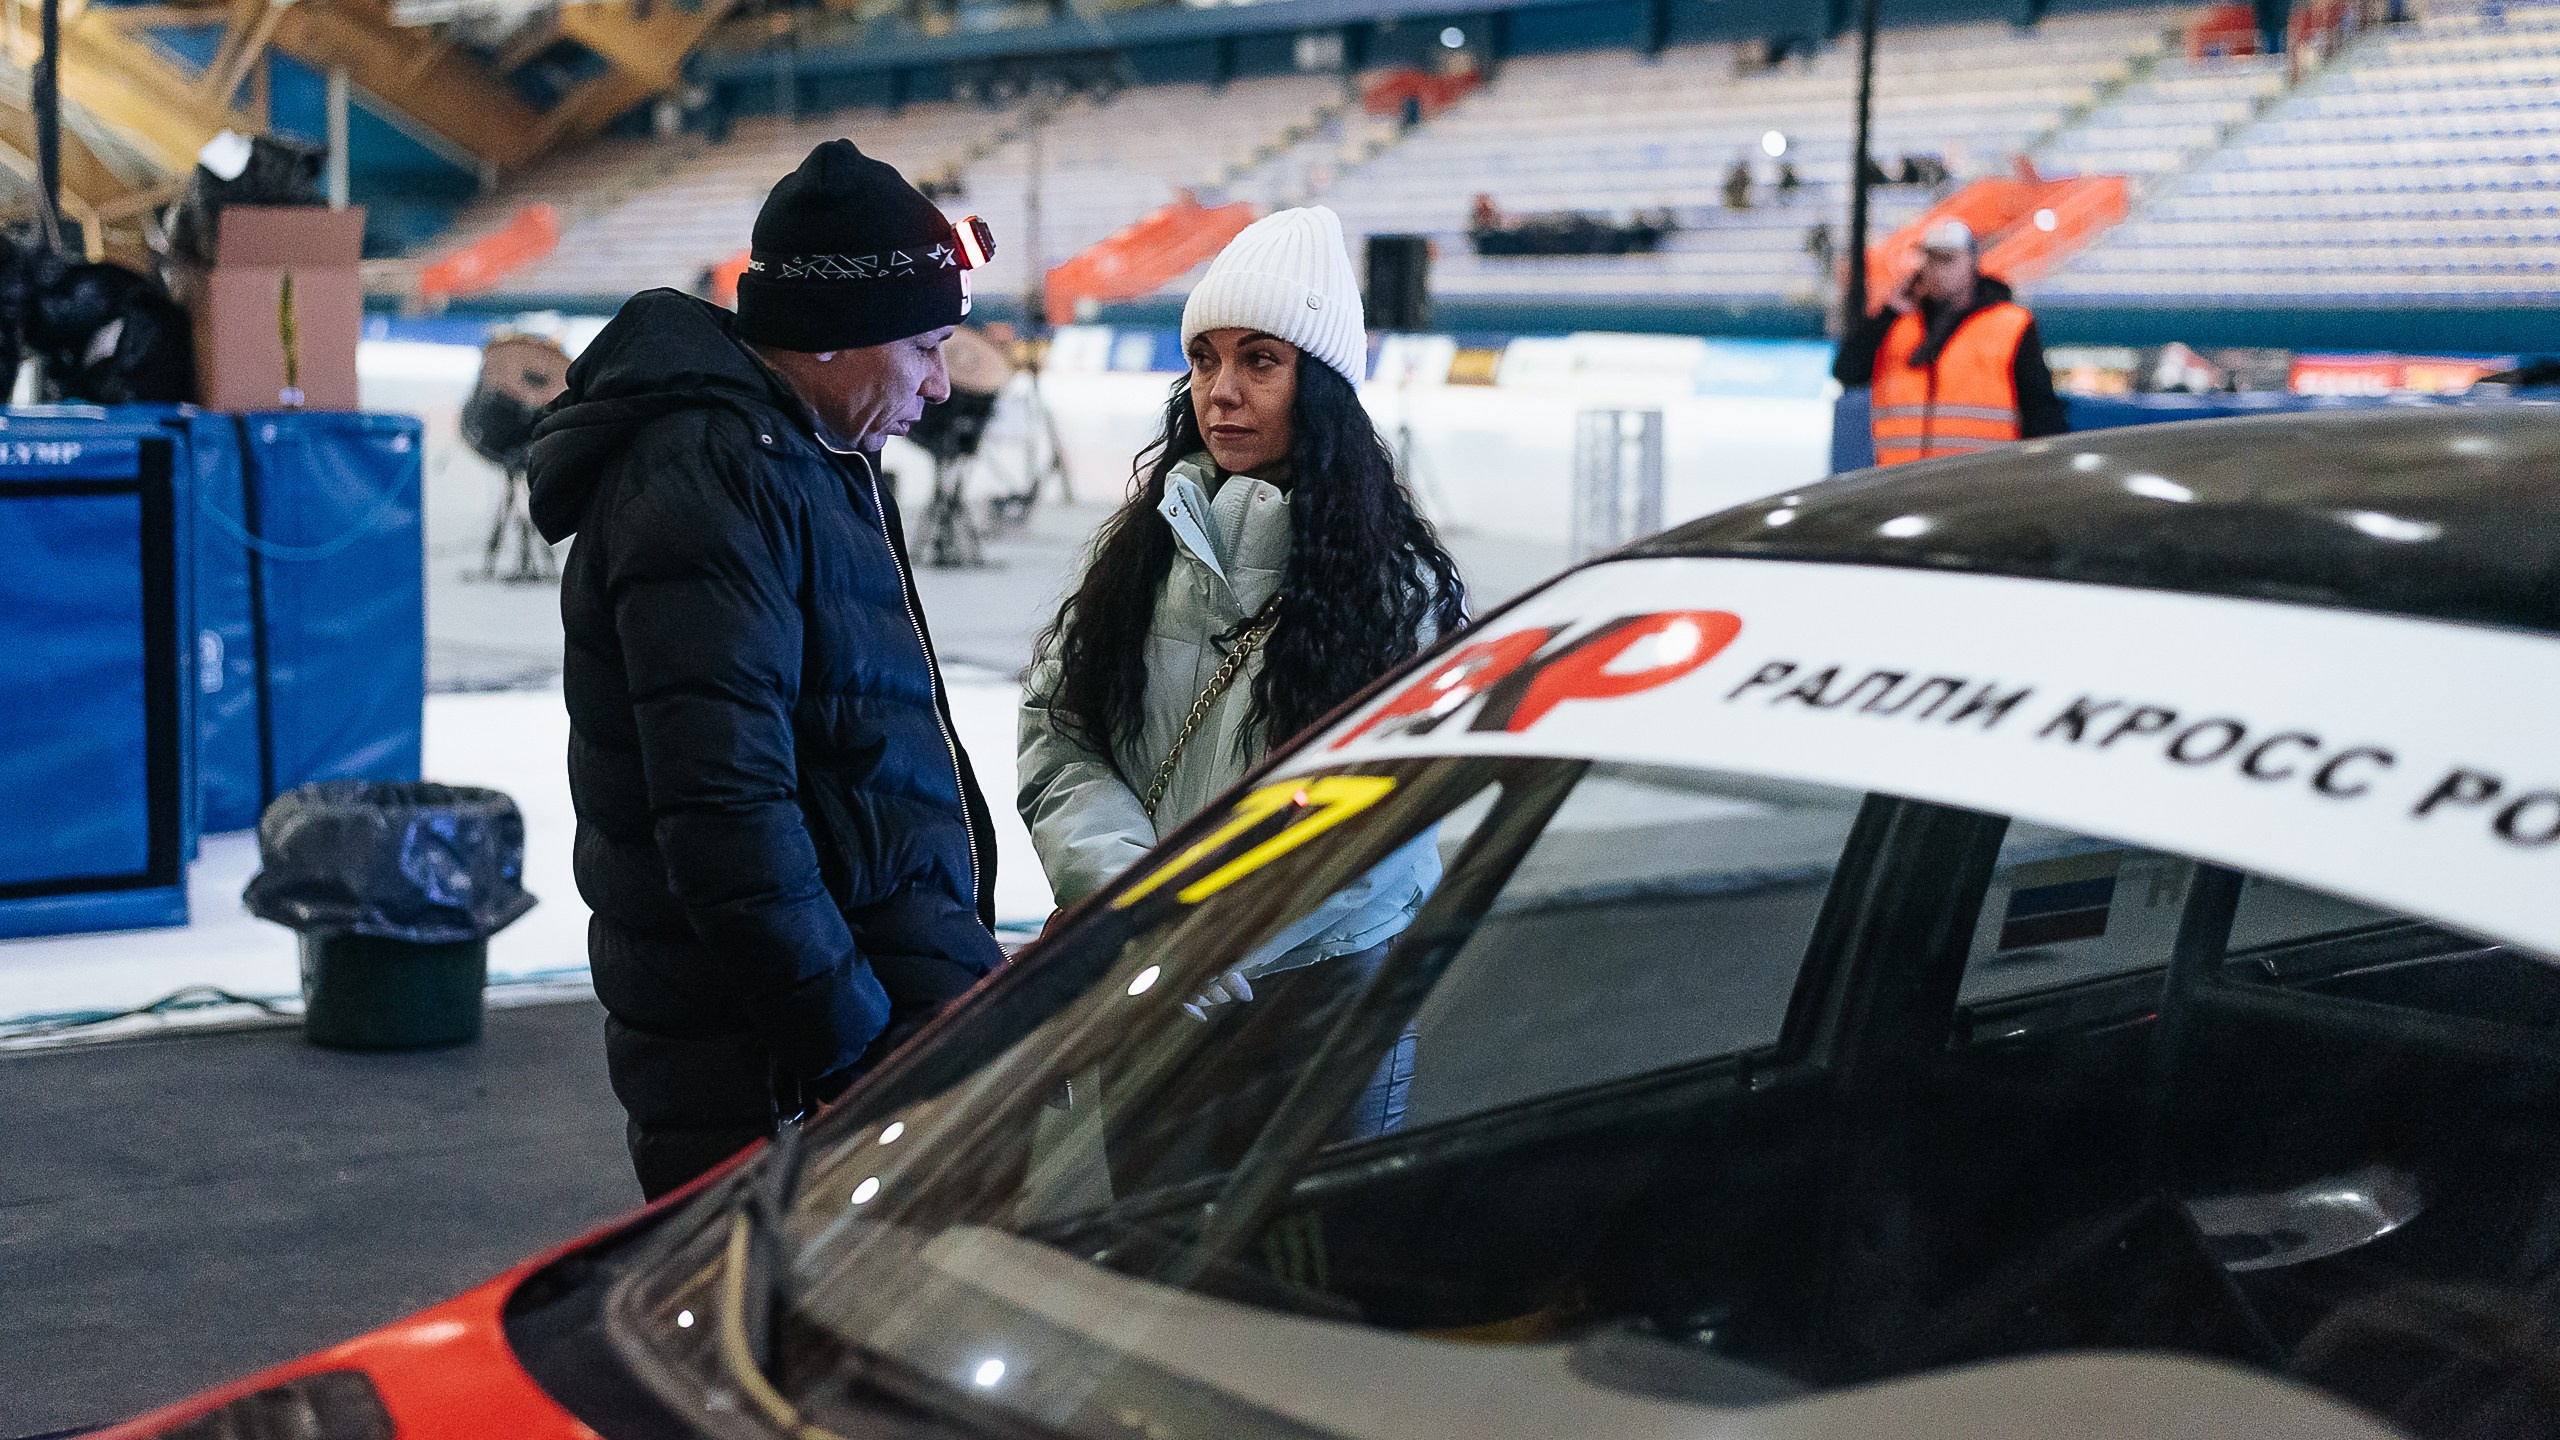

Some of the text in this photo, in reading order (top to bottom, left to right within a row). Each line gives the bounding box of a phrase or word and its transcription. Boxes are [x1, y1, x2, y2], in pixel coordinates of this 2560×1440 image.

[1723, 661, 2034, 729] РАЛЛИ
[2038, 697, 2395, 800] КРОСС
[1110, 776, 1397, 910] 17
